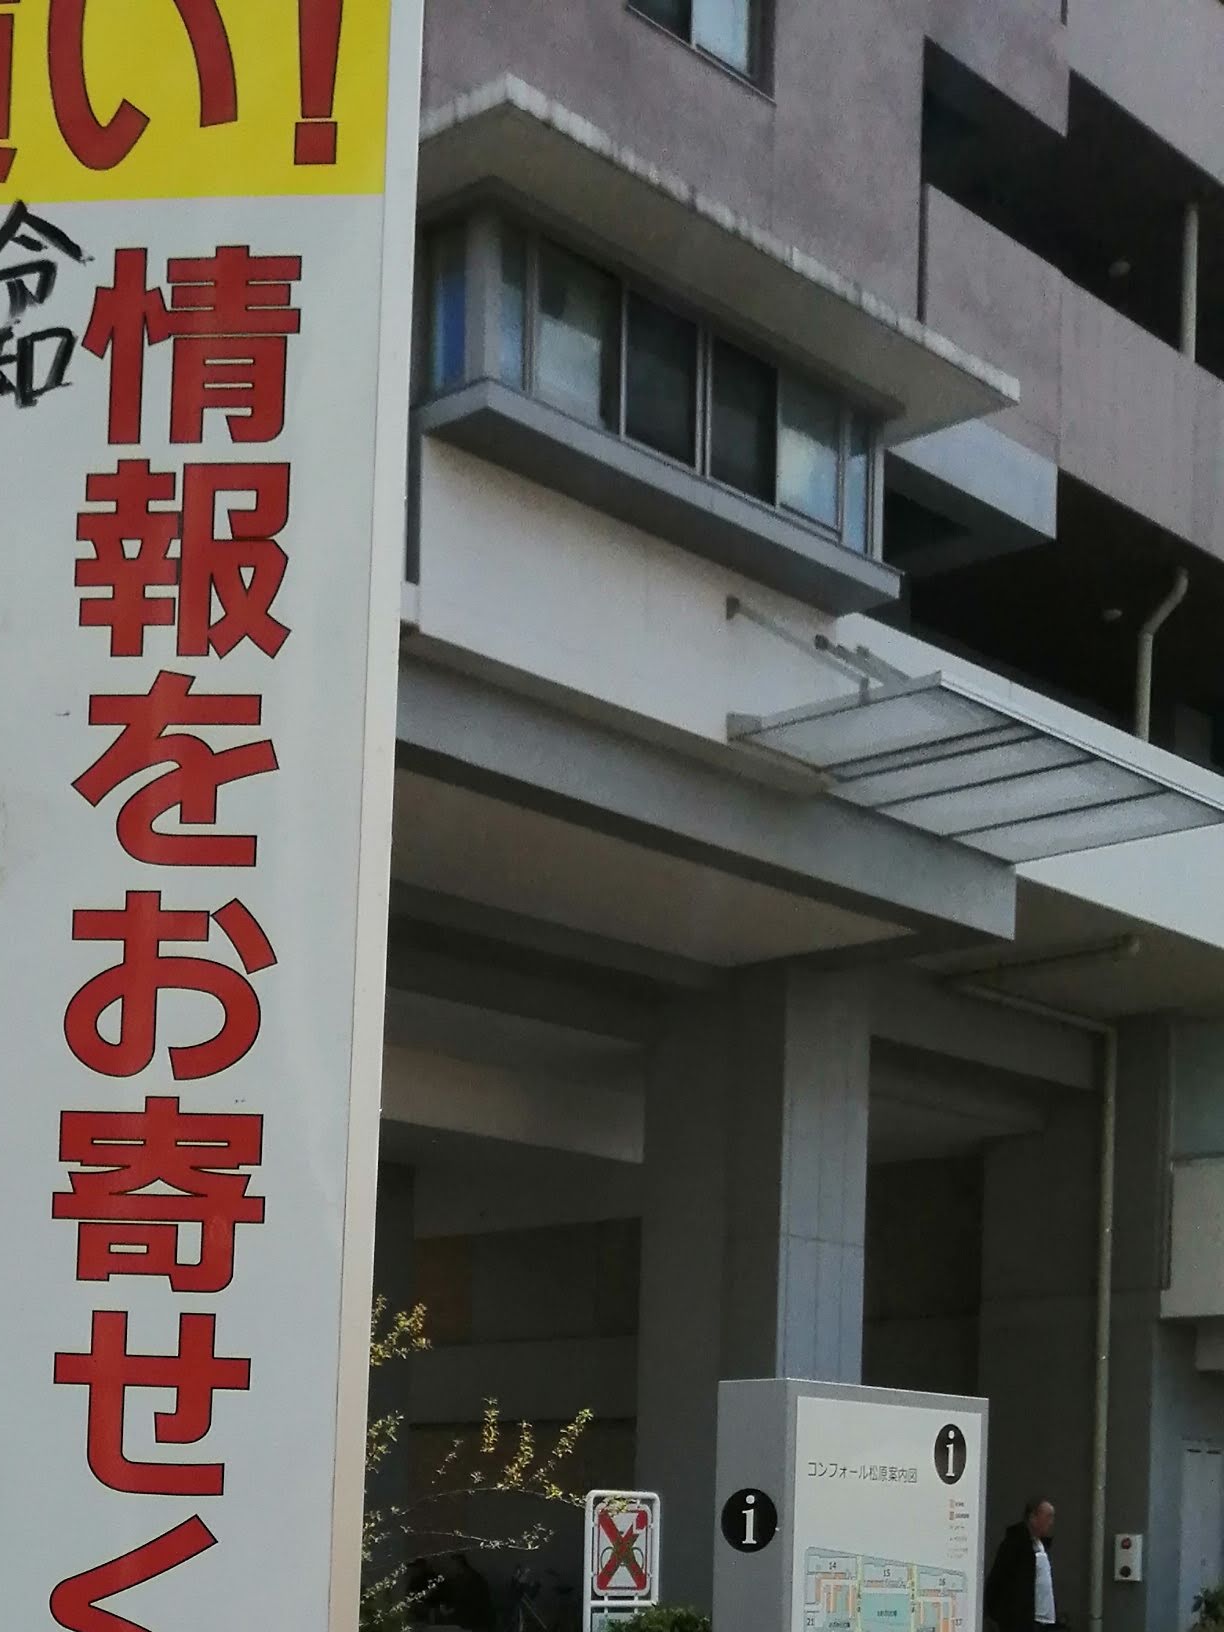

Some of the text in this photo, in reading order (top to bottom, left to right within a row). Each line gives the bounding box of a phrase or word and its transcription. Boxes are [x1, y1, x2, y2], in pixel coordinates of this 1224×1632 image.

[807, 1461, 918, 1484] コンフォール松原案内図
